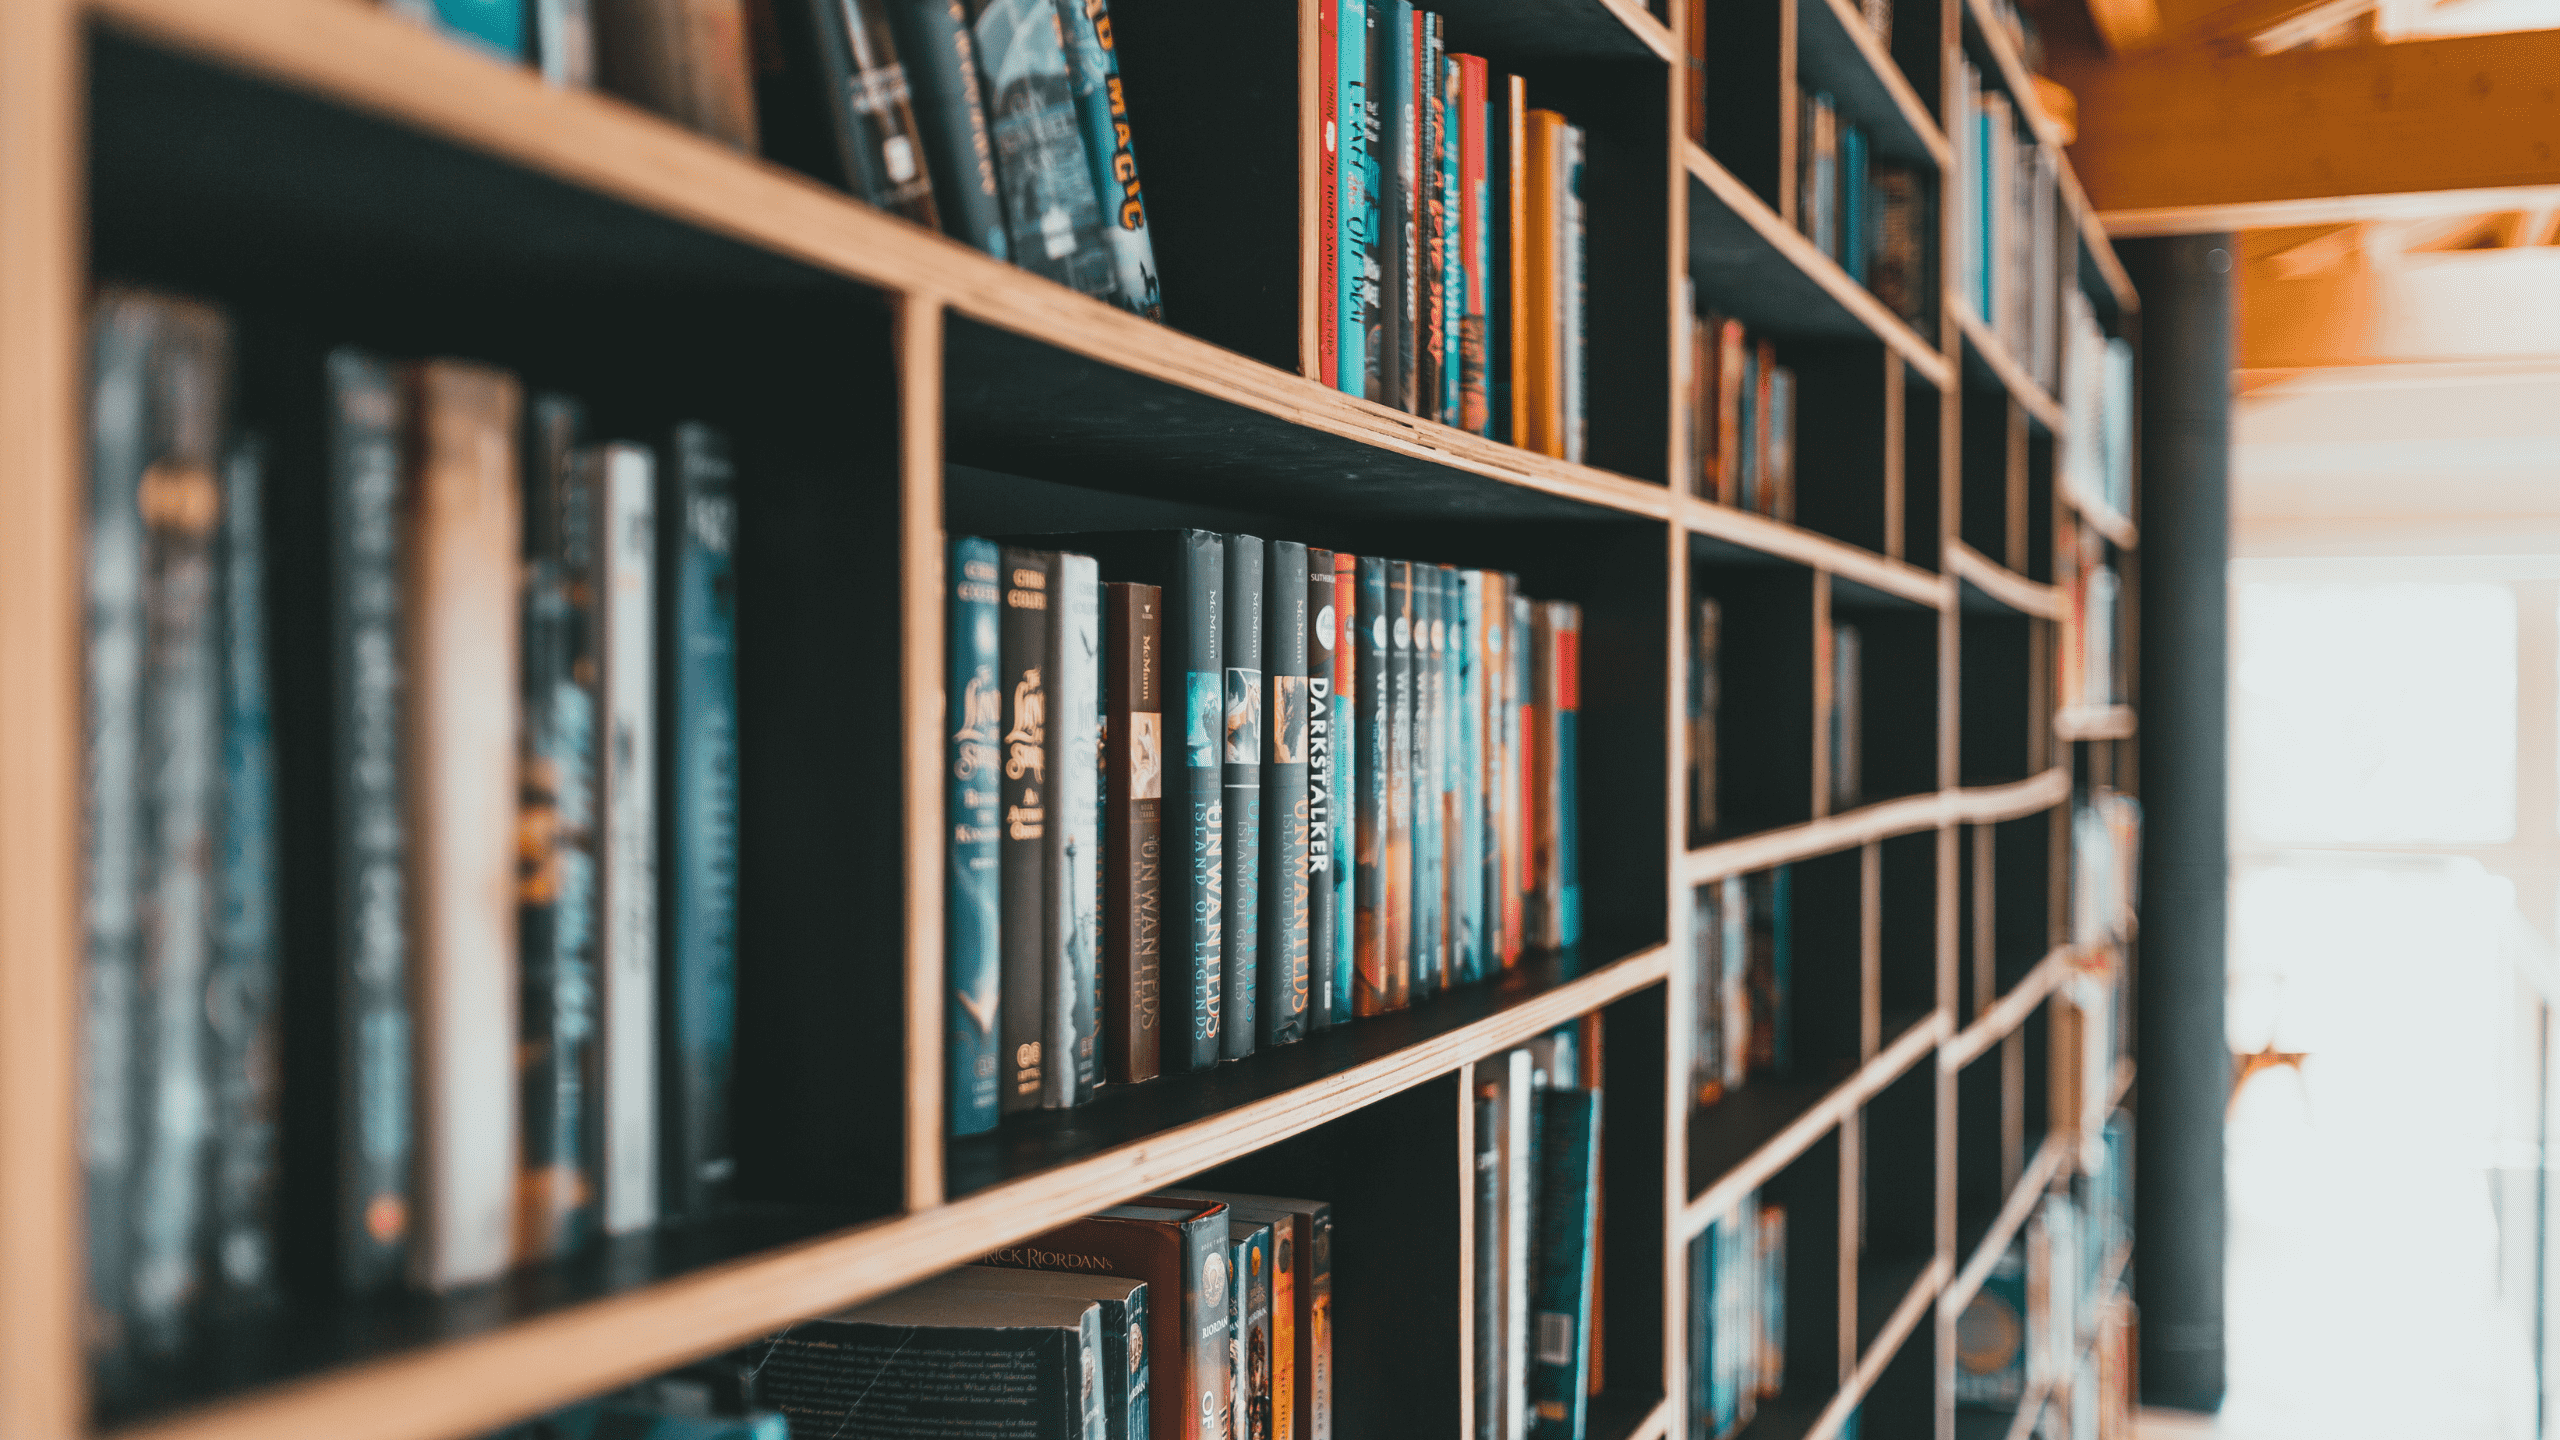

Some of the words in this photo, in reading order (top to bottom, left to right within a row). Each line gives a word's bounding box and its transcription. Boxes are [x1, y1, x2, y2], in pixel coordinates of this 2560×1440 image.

[1105, 74, 1144, 231] MAGIC
[1209, 590, 1217, 659] McMann
[1296, 599, 1304, 664] McMann
[1143, 635, 1151, 699] McMann
[1308, 677, 1330, 873] DARKSTALKER
[1194, 801, 1207, 886] ISLAND
[1237, 821, 1247, 888] ISLAND
[1282, 813, 1293, 878] ISLAND
[1195, 900, 1207, 926] OF
[1206, 806, 1222, 1038] UNWANTEDS
[1236, 898, 1247, 917] OF
[1245, 800, 1260, 1023] UNWANTEDS
[1282, 886, 1293, 907] OF
[1291, 800, 1309, 1013] UNWANTEDS
[1141, 840, 1159, 1030] UNWANTEDS
[1235, 928, 1247, 1001] GRAVES
[1282, 916, 1293, 999] DRAGONS
[1194, 941, 1207, 1041] LEGENDS
[984, 1248, 1024, 1265] RICK
[923, 1350, 955, 1358] anything
[985, 1350, 1011, 1358] waking
[1202, 1315, 1228, 1339] RIORDAN
[964, 1383, 986, 1391] What
[989, 1383, 1001, 1391] did
[993, 1372, 1036, 1380] Wilderness
[1013, 1359, 1037, 1370] Piper,
[1005, 1418, 1016, 1426] for
[1009, 1430, 1036, 1438] trouble
[1202, 1390, 1214, 1429] OF
